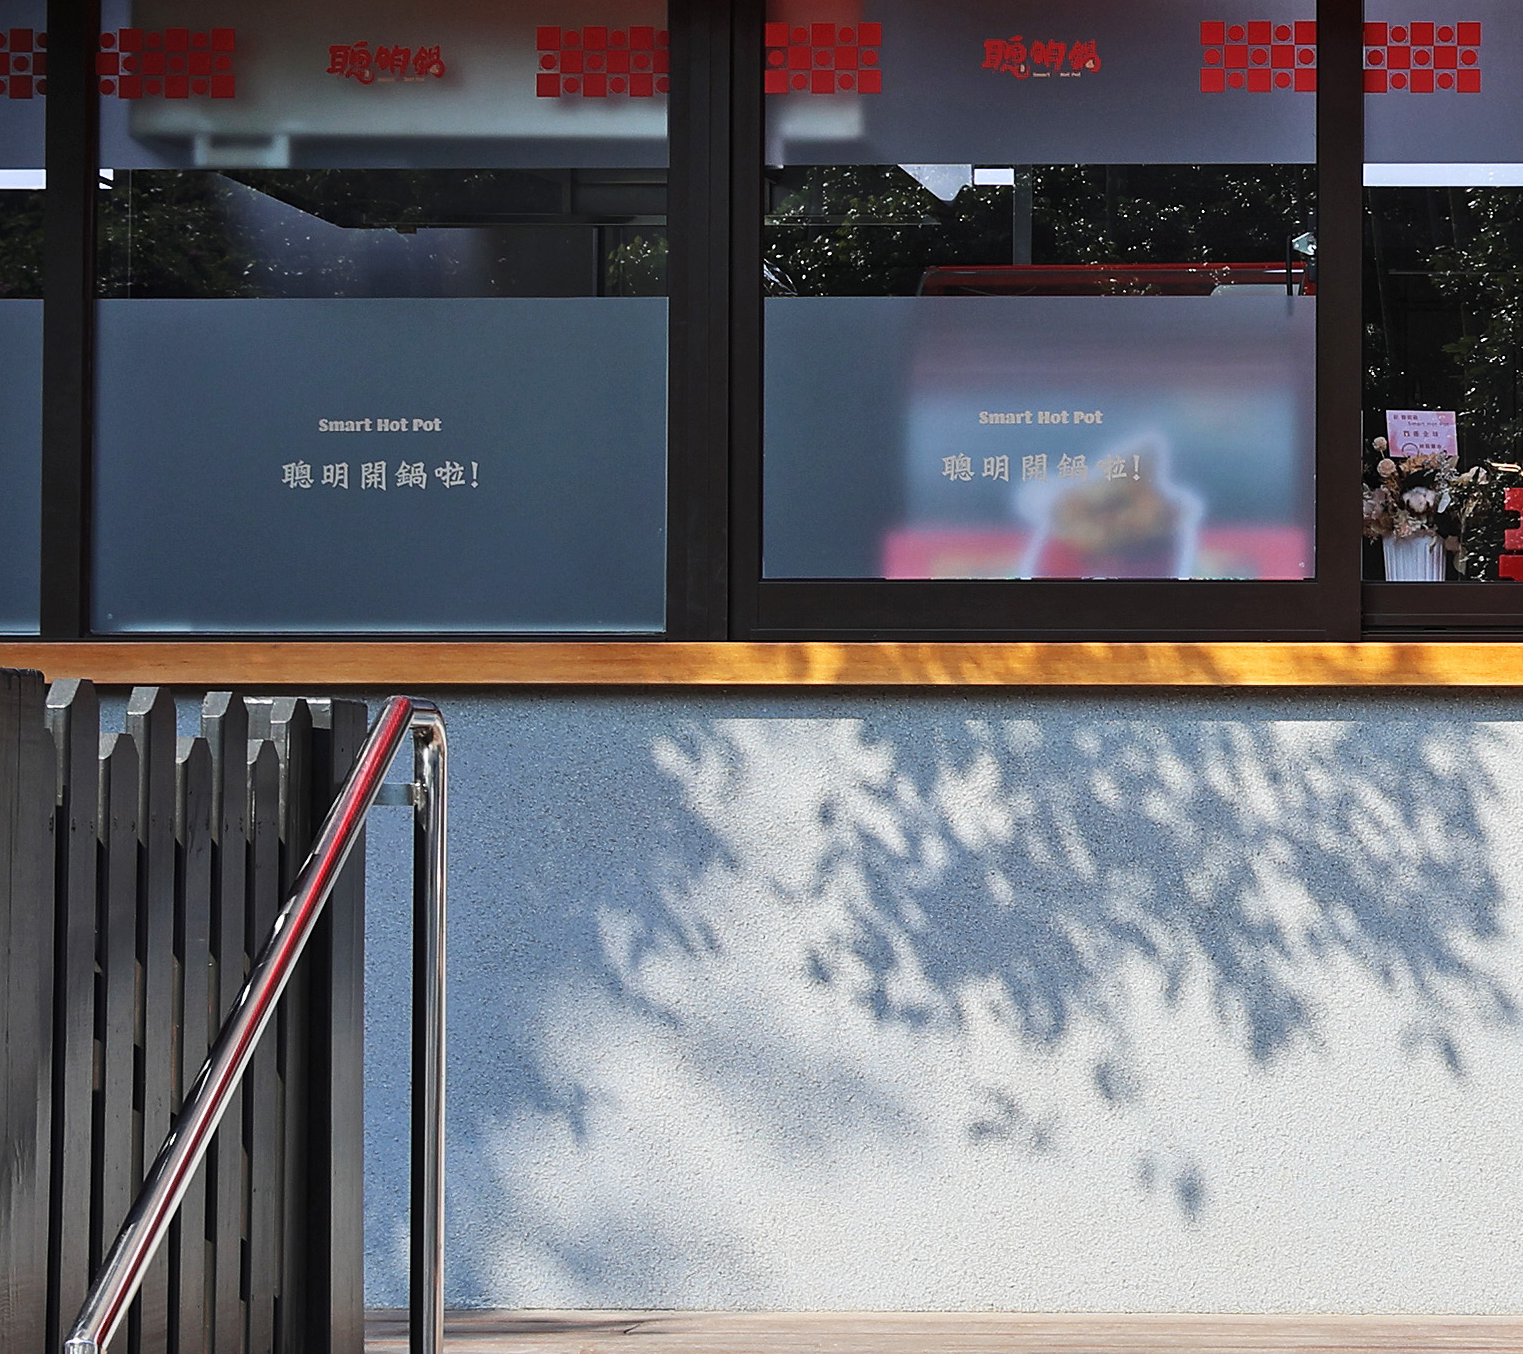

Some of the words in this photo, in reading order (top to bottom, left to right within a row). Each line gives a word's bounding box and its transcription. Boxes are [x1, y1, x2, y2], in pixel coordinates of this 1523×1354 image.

[319, 418, 372, 432] Smart
[377, 418, 408, 432] Hot
[413, 418, 442, 432] Pot
[979, 411, 1032, 424] Smart
[1038, 411, 1069, 424] Hot
[1074, 411, 1103, 424] Pot
[281, 460, 479, 490] 聰明開鍋啦!
[942, 453, 1140, 482] 聰明開鍋啦!
